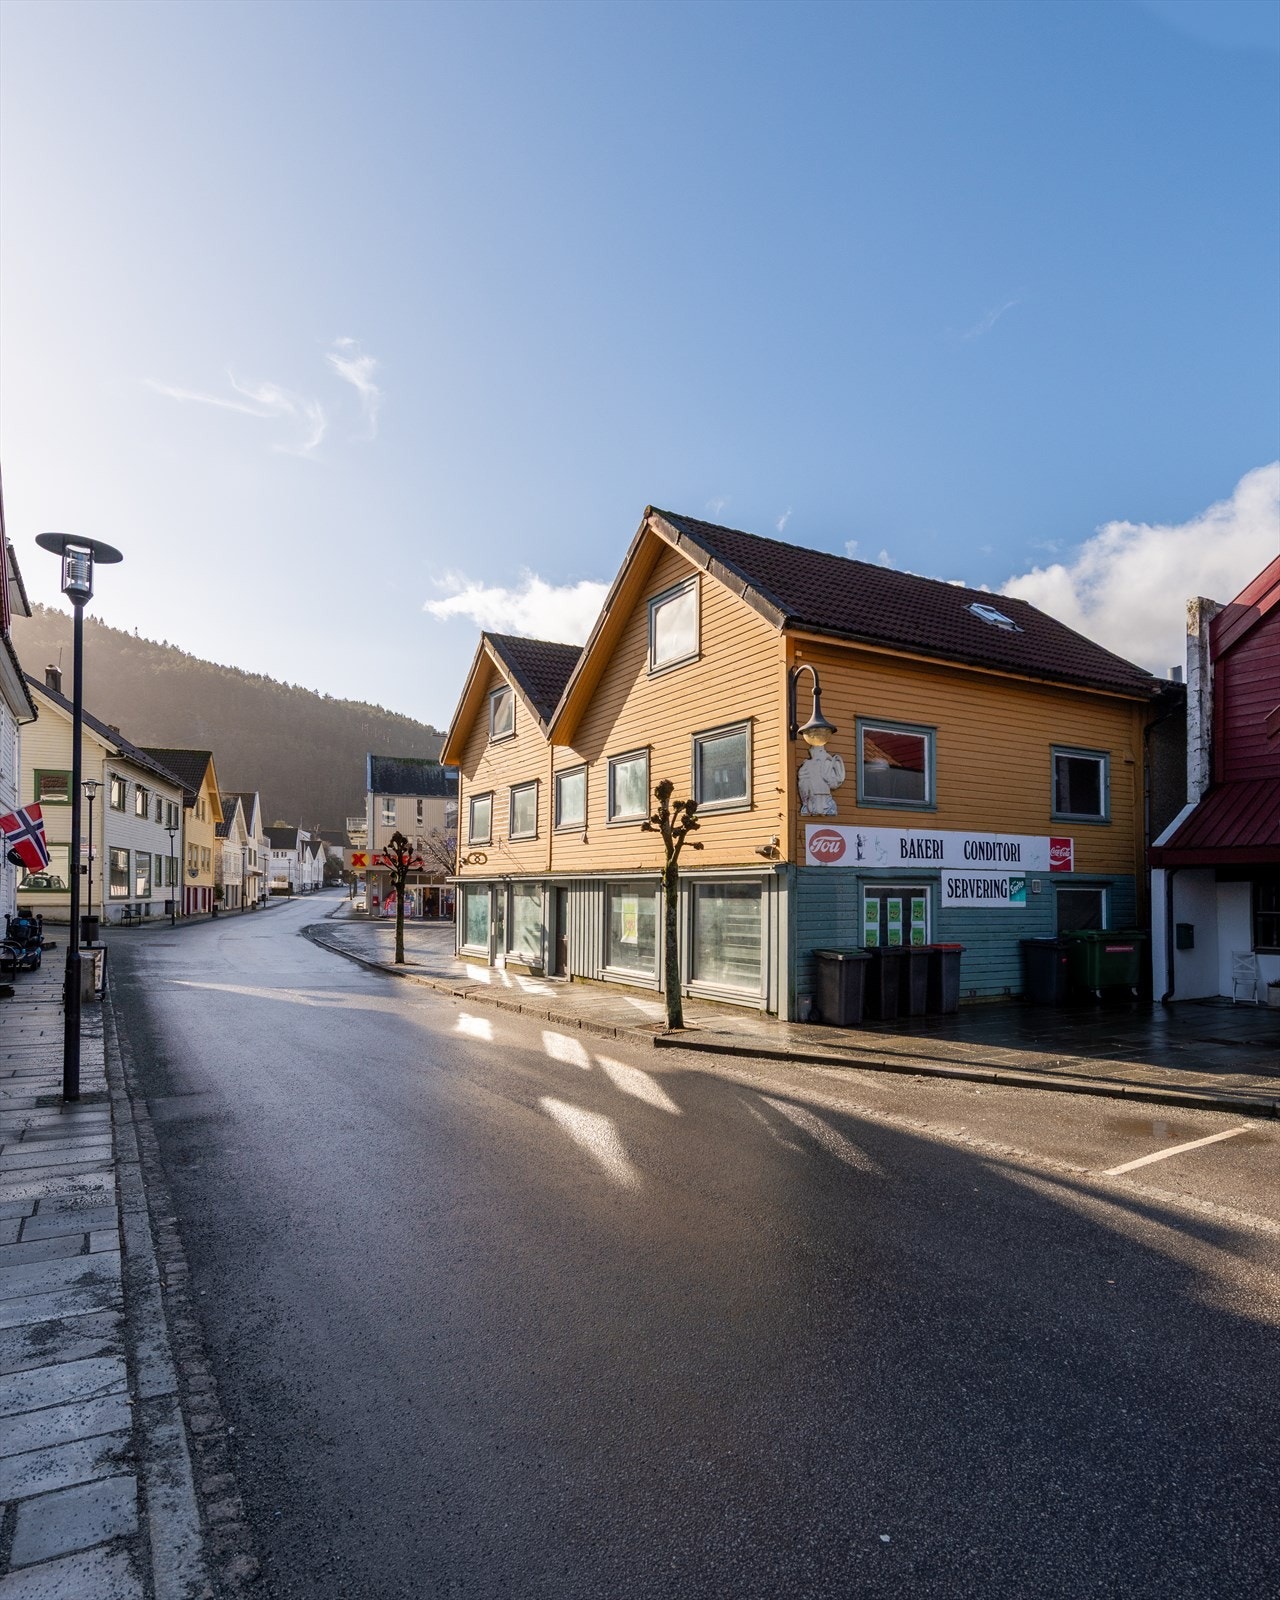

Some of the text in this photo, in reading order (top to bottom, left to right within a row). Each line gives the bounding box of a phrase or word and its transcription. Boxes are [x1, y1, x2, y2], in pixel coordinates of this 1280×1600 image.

[900, 838, 1021, 862] BAKERI CONDITORI
[947, 878, 1008, 899] SERVERING
